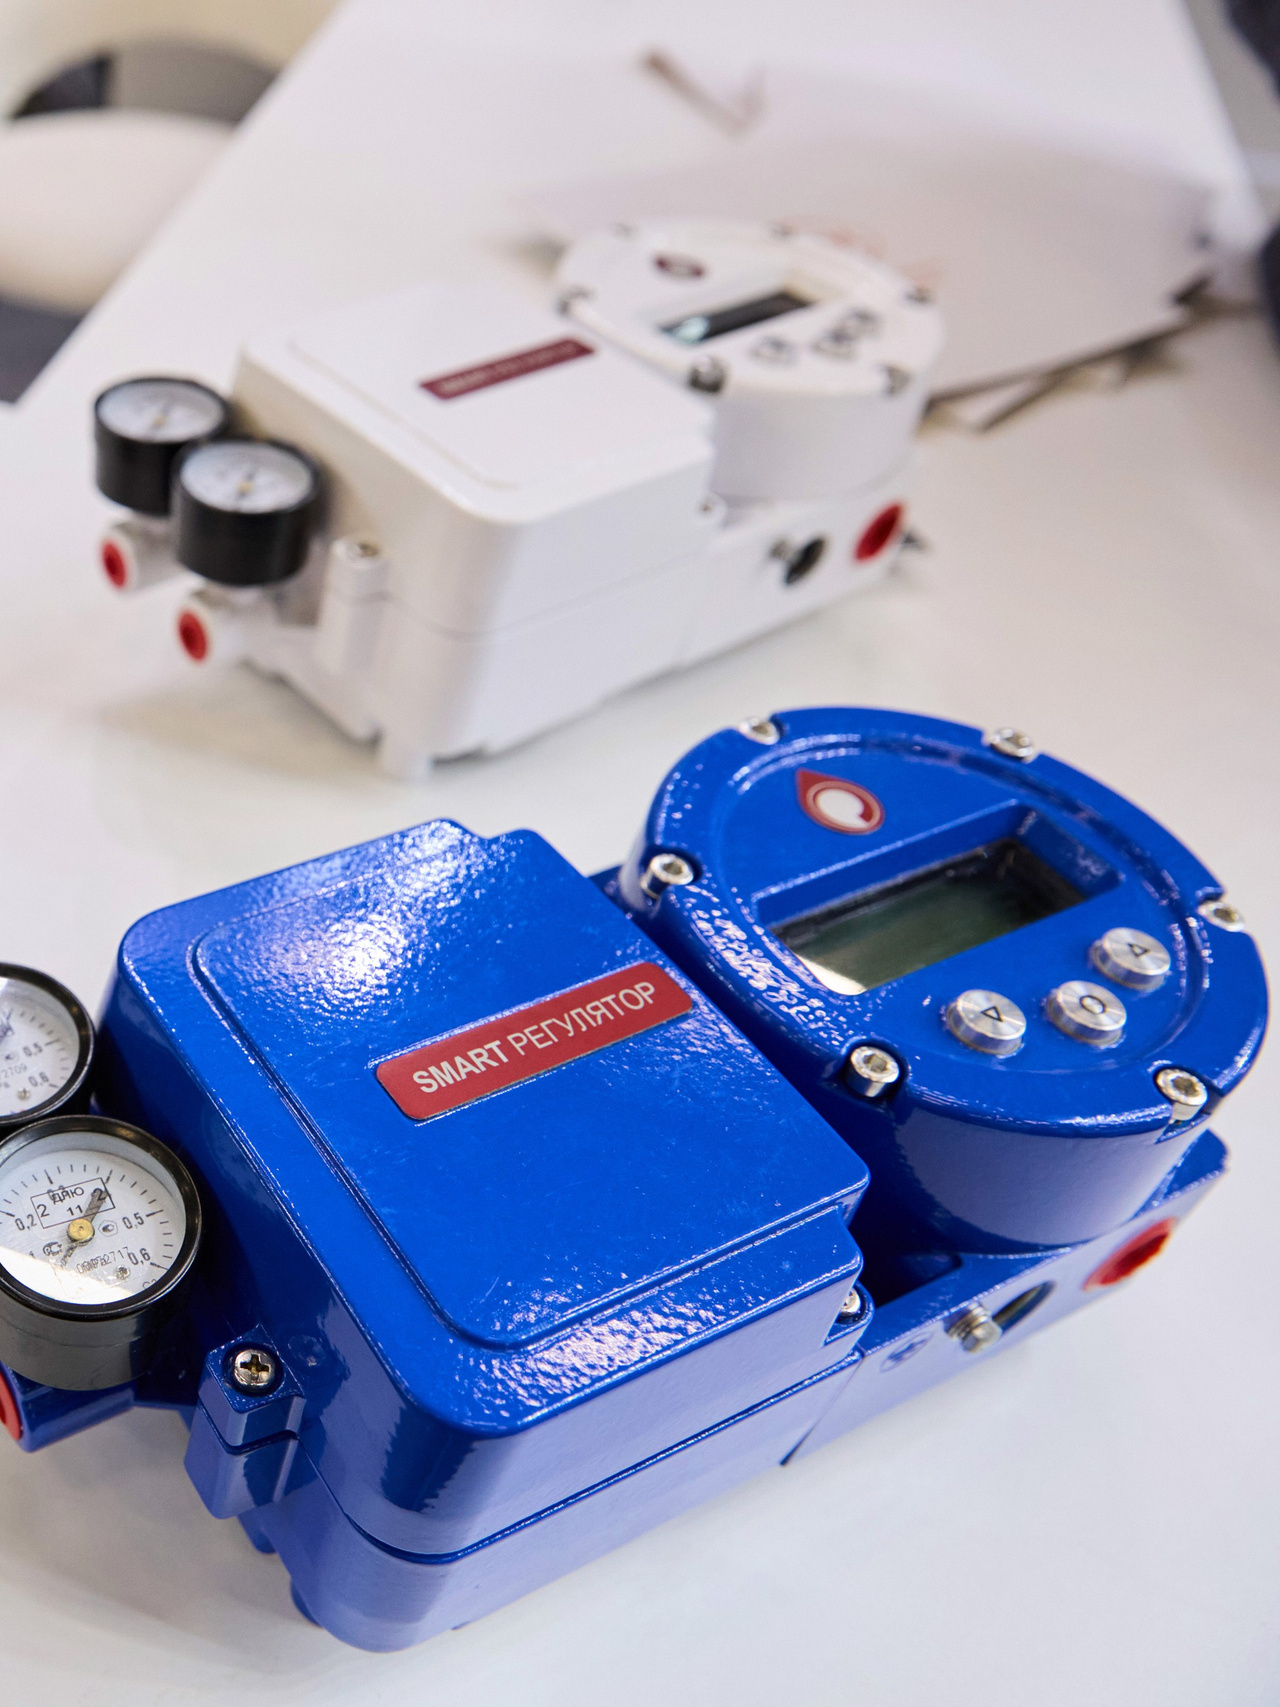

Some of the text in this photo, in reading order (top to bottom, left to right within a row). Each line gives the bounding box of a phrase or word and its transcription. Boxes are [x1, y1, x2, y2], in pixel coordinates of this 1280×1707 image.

[412, 981, 656, 1093] SMART РЕГУЛЯТОР
[37, 1203, 50, 1218] 2
[67, 1204, 83, 1216] 11
[15, 1213, 37, 1231] 0,2
[122, 1212, 144, 1230] 0,5
[128, 1247, 151, 1266] 0,6
